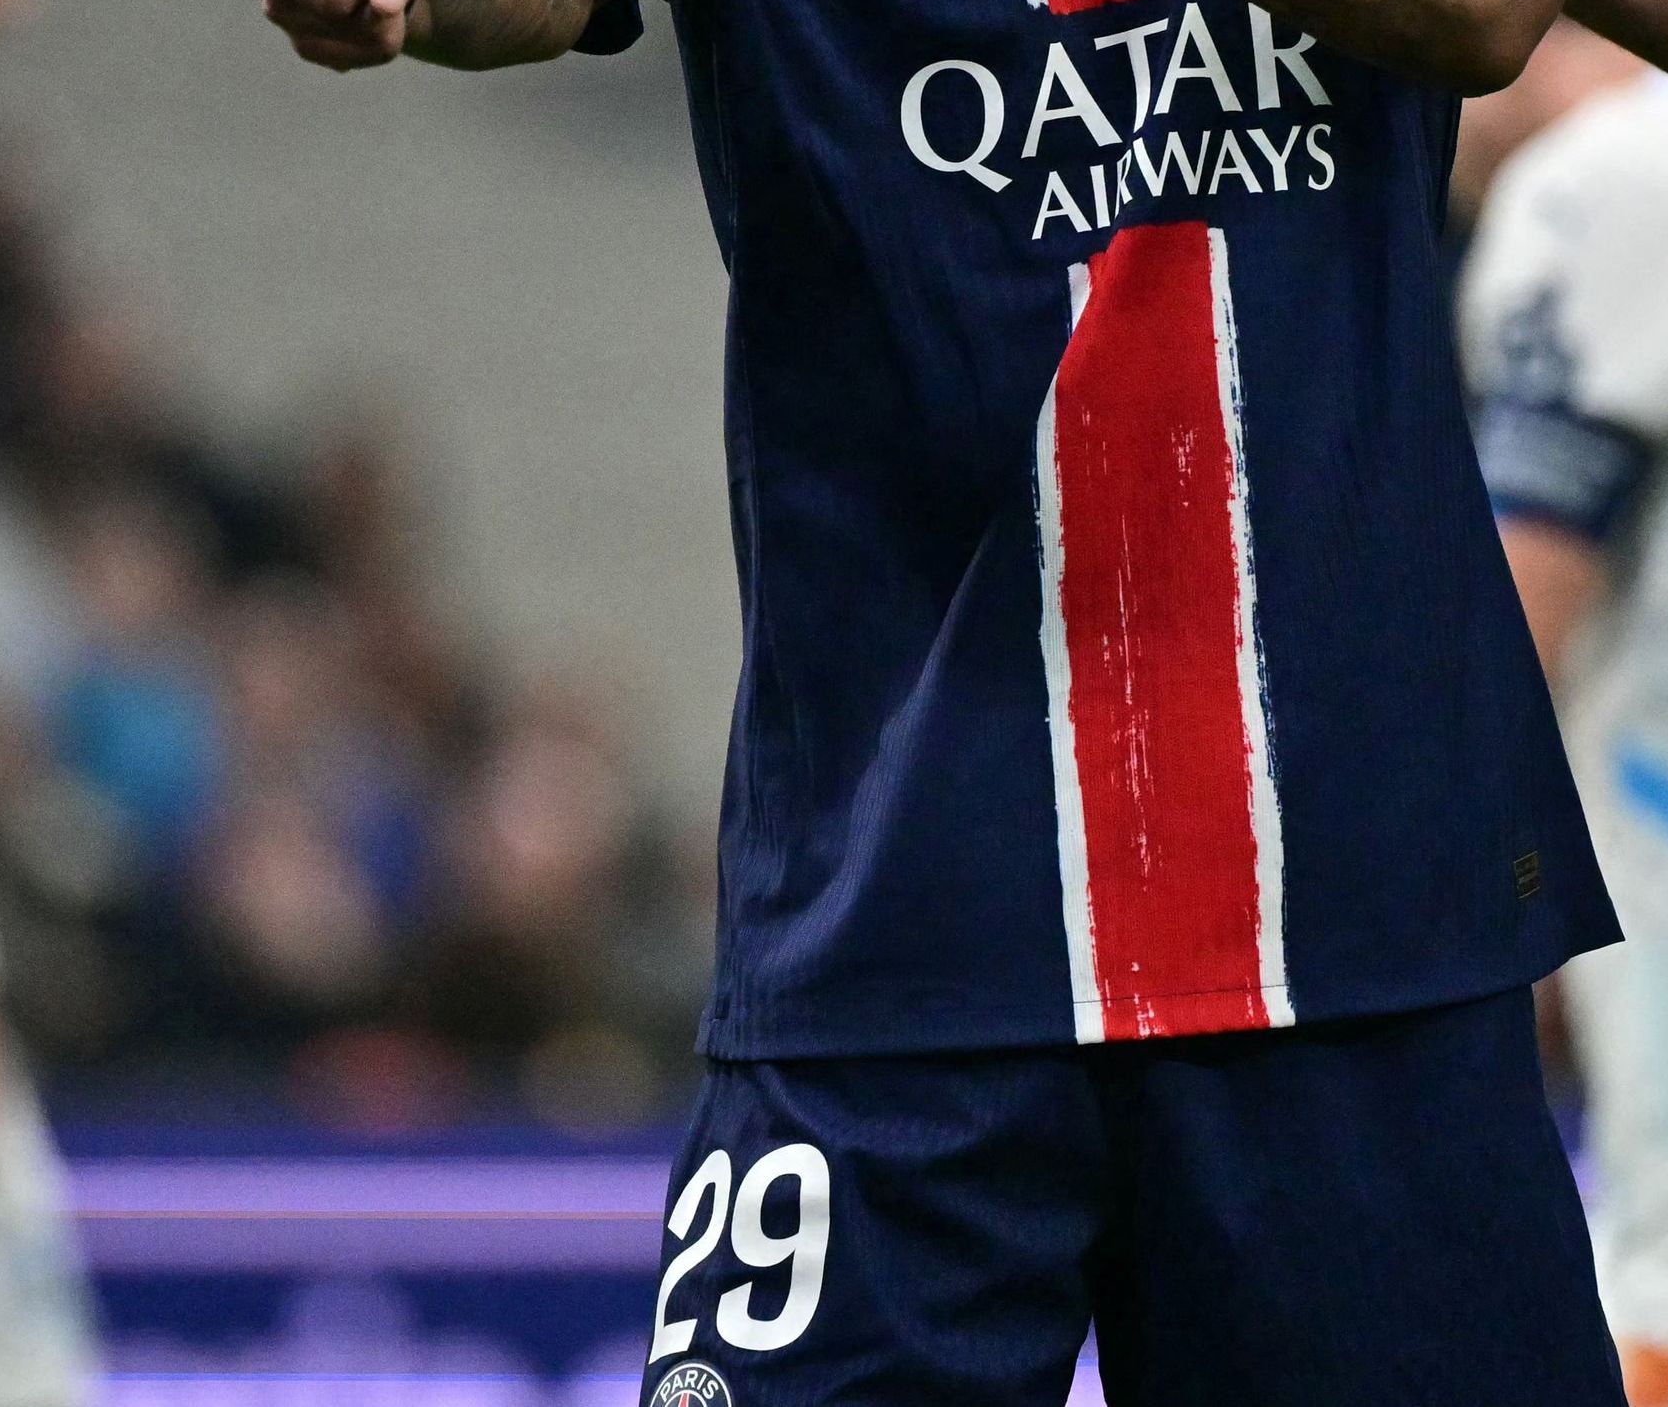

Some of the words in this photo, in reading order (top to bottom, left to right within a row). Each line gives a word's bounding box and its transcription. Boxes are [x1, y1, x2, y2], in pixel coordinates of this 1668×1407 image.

[900, 2, 1331, 193] QATAR
[1031, 122, 1336, 241] AIRWAYS
[648, 1142, 831, 1365] 29
[659, 1369, 720, 1403] PARIS
